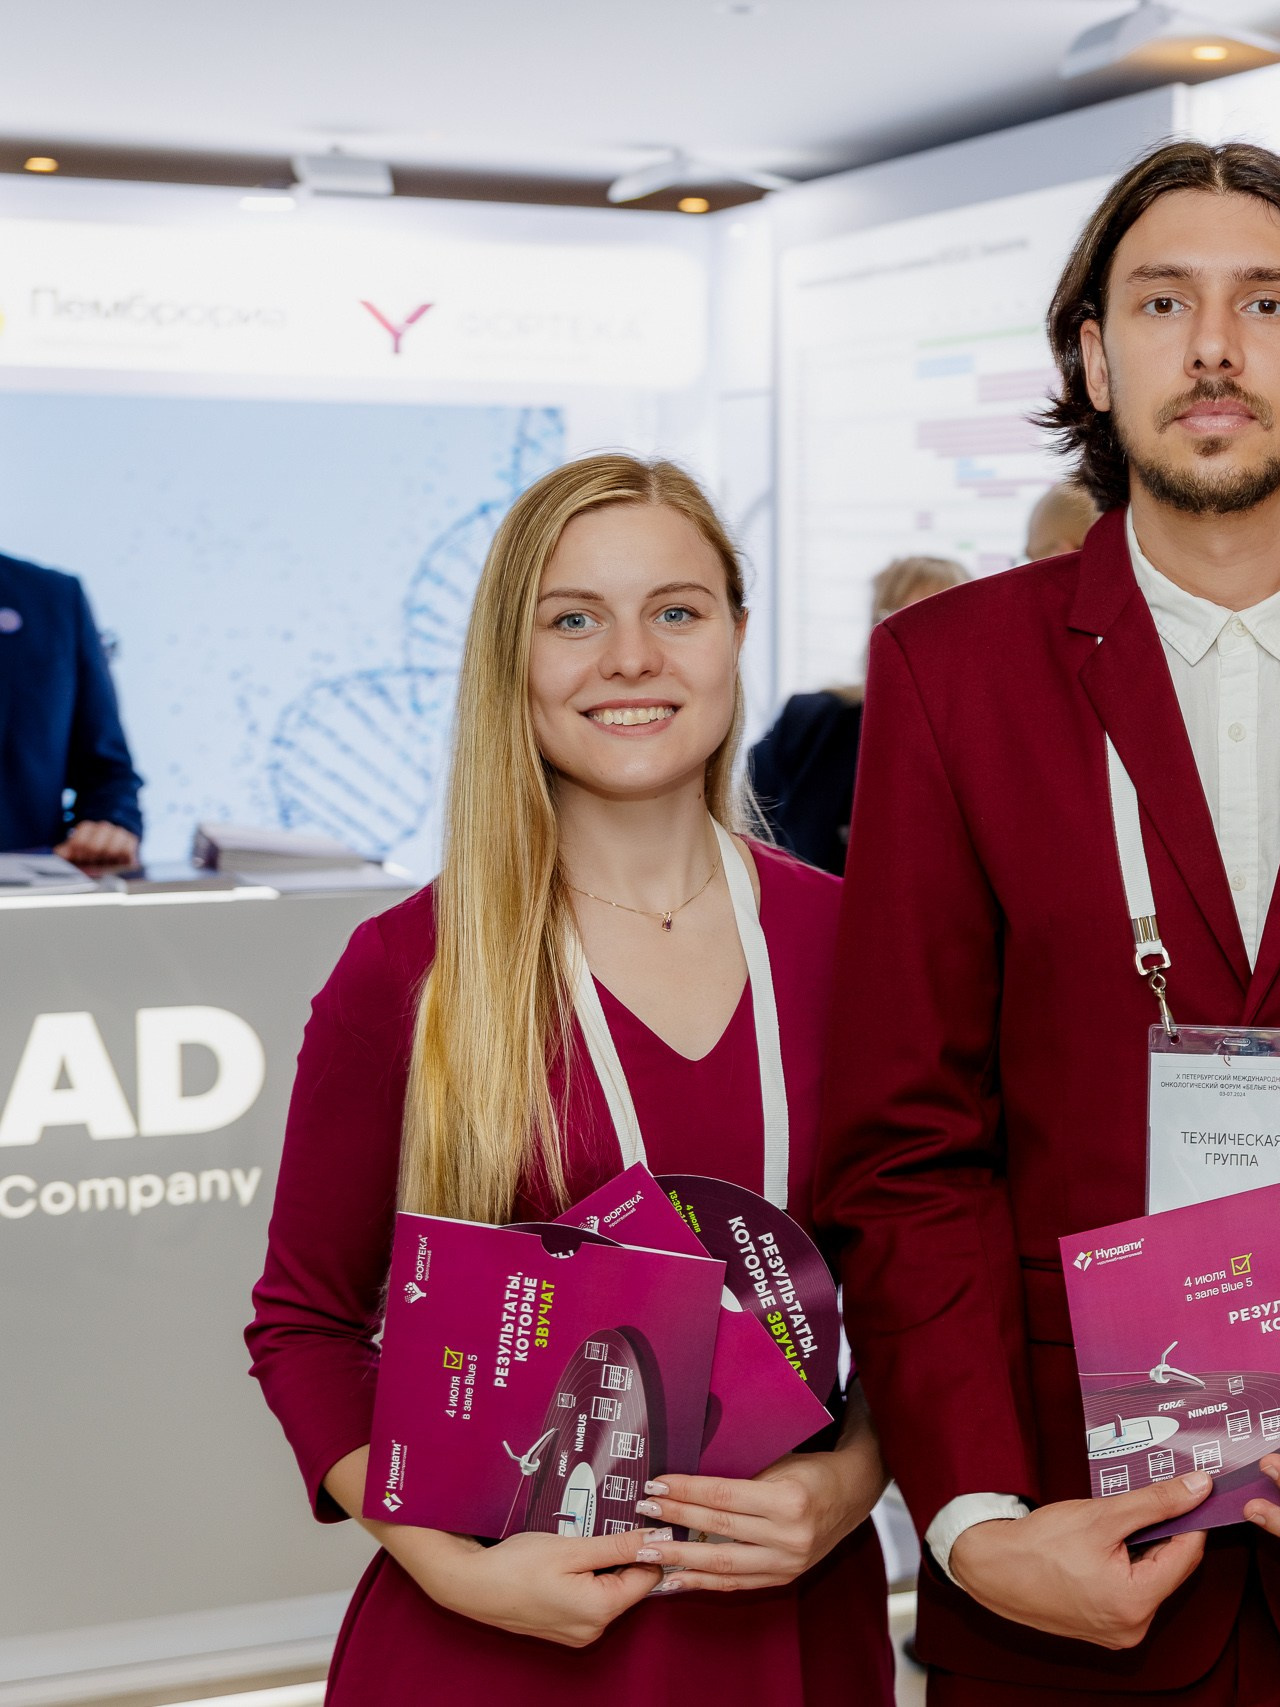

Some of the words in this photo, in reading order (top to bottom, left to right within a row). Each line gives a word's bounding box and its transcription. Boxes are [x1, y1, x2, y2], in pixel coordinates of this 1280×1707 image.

[0, 1005, 266, 1147] AD
[1160, 1081, 1218, 1089] ОНКОЛОГИЧЕСКИЙ
[1220, 1082, 1241, 1090] ФОРУМ
[1182, 1073, 1231, 1081] ПЕТЕРБУРГСКИЙ
[1205, 1152, 1259, 1167] ГРУППА
[0, 1166, 262, 1219] Company
[728, 1215, 777, 1309] КОТОРЫЕ
[1184, 1276, 1192, 1287] 4
[1195, 1269, 1226, 1286] июля
[1186, 1294, 1193, 1302] в
[1195, 1286, 1219, 1300] зале
[1221, 1280, 1243, 1294] Blue
[1246, 1277, 1253, 1287] 5
[757, 1232, 818, 1359] РЕЗУЛЬТАТЫ,
[514, 1277, 538, 1362] КОТОРЫЕ
[534, 1280, 555, 1348] ЗВУЧАТ
[493, 1271, 523, 1388] РЕЗУЛЬТАТЫ,
[467, 1354, 478, 1362] 5
[465, 1363, 477, 1385] Blue
[449, 1375, 461, 1407] июля
[463, 1387, 474, 1412] зале
[445, 1409, 457, 1418] 4
[1188, 1402, 1228, 1419] NIMBUS
[574, 1413, 587, 1452] NIMBUS
[1092, 1442, 1150, 1457] HARMONY
